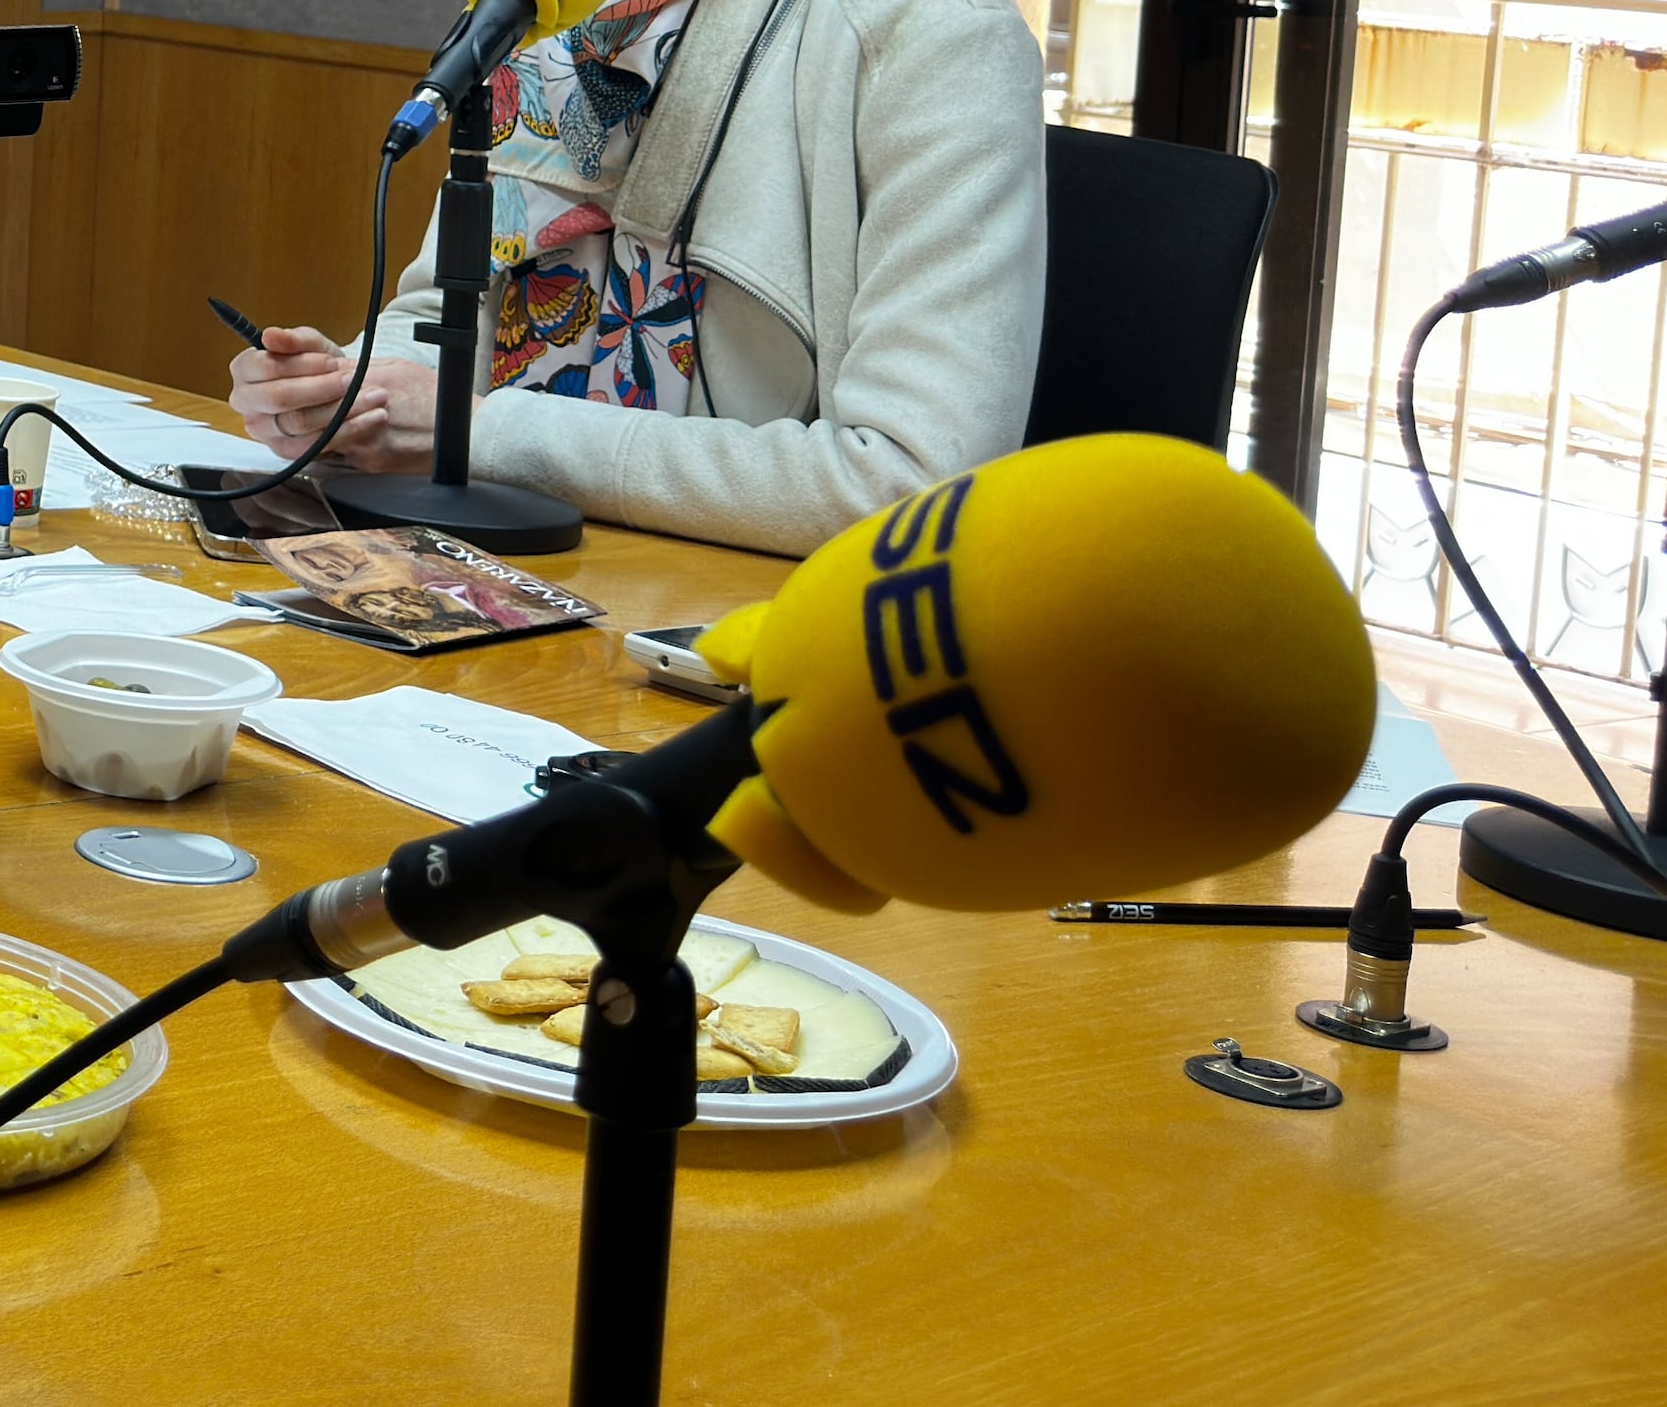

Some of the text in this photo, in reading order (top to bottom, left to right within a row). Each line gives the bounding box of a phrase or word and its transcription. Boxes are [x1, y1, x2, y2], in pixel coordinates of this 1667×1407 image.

[435, 541, 589, 615] NAZARENO
[863, 473, 1031, 836] SER
[1107, 904, 1155, 920] SER
